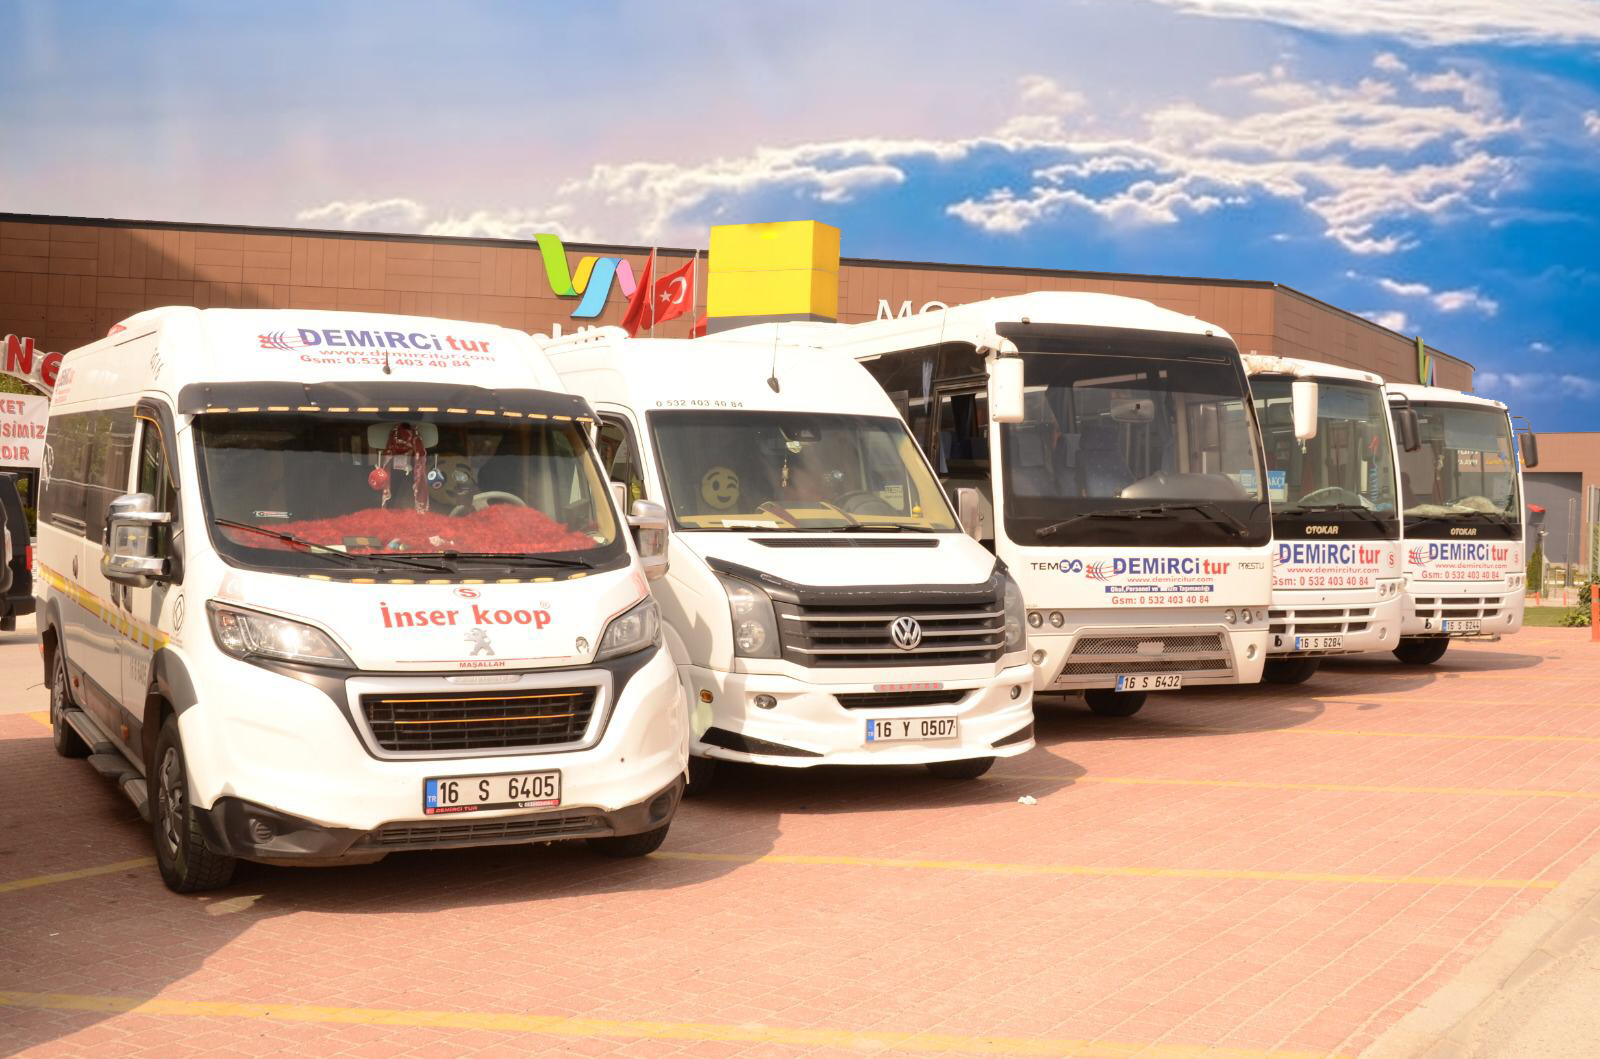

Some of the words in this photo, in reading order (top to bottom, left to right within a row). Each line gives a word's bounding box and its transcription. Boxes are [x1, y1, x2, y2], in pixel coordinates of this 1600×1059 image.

[445, 335, 490, 353] tur
[300, 354, 342, 364] Gsm:
[395, 358, 424, 367] 403
[428, 360, 447, 368] 40
[451, 360, 471, 368] 84
[666, 399, 687, 407] 532
[0, 445, 30, 461] DIR
[1305, 525, 1339, 535] OTOKAR
[1450, 527, 1478, 536] OTOKAR
[1359, 545, 1381, 565] tur
[1491, 544, 1509, 561] tur
[1203, 559, 1230, 575] tur
[1287, 566, 1380, 574] www.demircitur.com
[1272, 575, 1296, 586] Gsm:
[1299, 576, 1306, 586] 0
[1308, 576, 1325, 586] 532
[1328, 576, 1344, 586] 403
[1346, 576, 1357, 586] 40
[1359, 576, 1369, 586] 84
[1421, 570, 1443, 579] Gsm:
[1452, 570, 1465, 579] 532
[1467, 570, 1480, 579] 403
[1481, 570, 1490, 579] 40
[1491, 570, 1499, 579] 84
[1112, 596, 1137, 605] Gsm:
[1140, 596, 1145, 605] 0
[1148, 596, 1164, 604] 532
[1168, 595, 1183, 604] 403
[1186, 595, 1197, 604] 40
[1199, 595, 1210, 604] 84
[471, 604, 551, 630] koop
[1300, 638, 1309, 648] 16
[1314, 638, 1319, 648] S
[1323, 637, 1341, 647] 6284
[1124, 677, 1136, 688] 16
[1142, 677, 1149, 688] S
[1155, 675, 1180, 688] 6432
[876, 721, 892, 738] 16
[903, 721, 911, 737] Y
[921, 719, 954, 737] 0507
[427, 795, 437, 803] TR
[440, 781, 459, 804] 16
[478, 779, 490, 802] S
[508, 775, 555, 800] 6405
